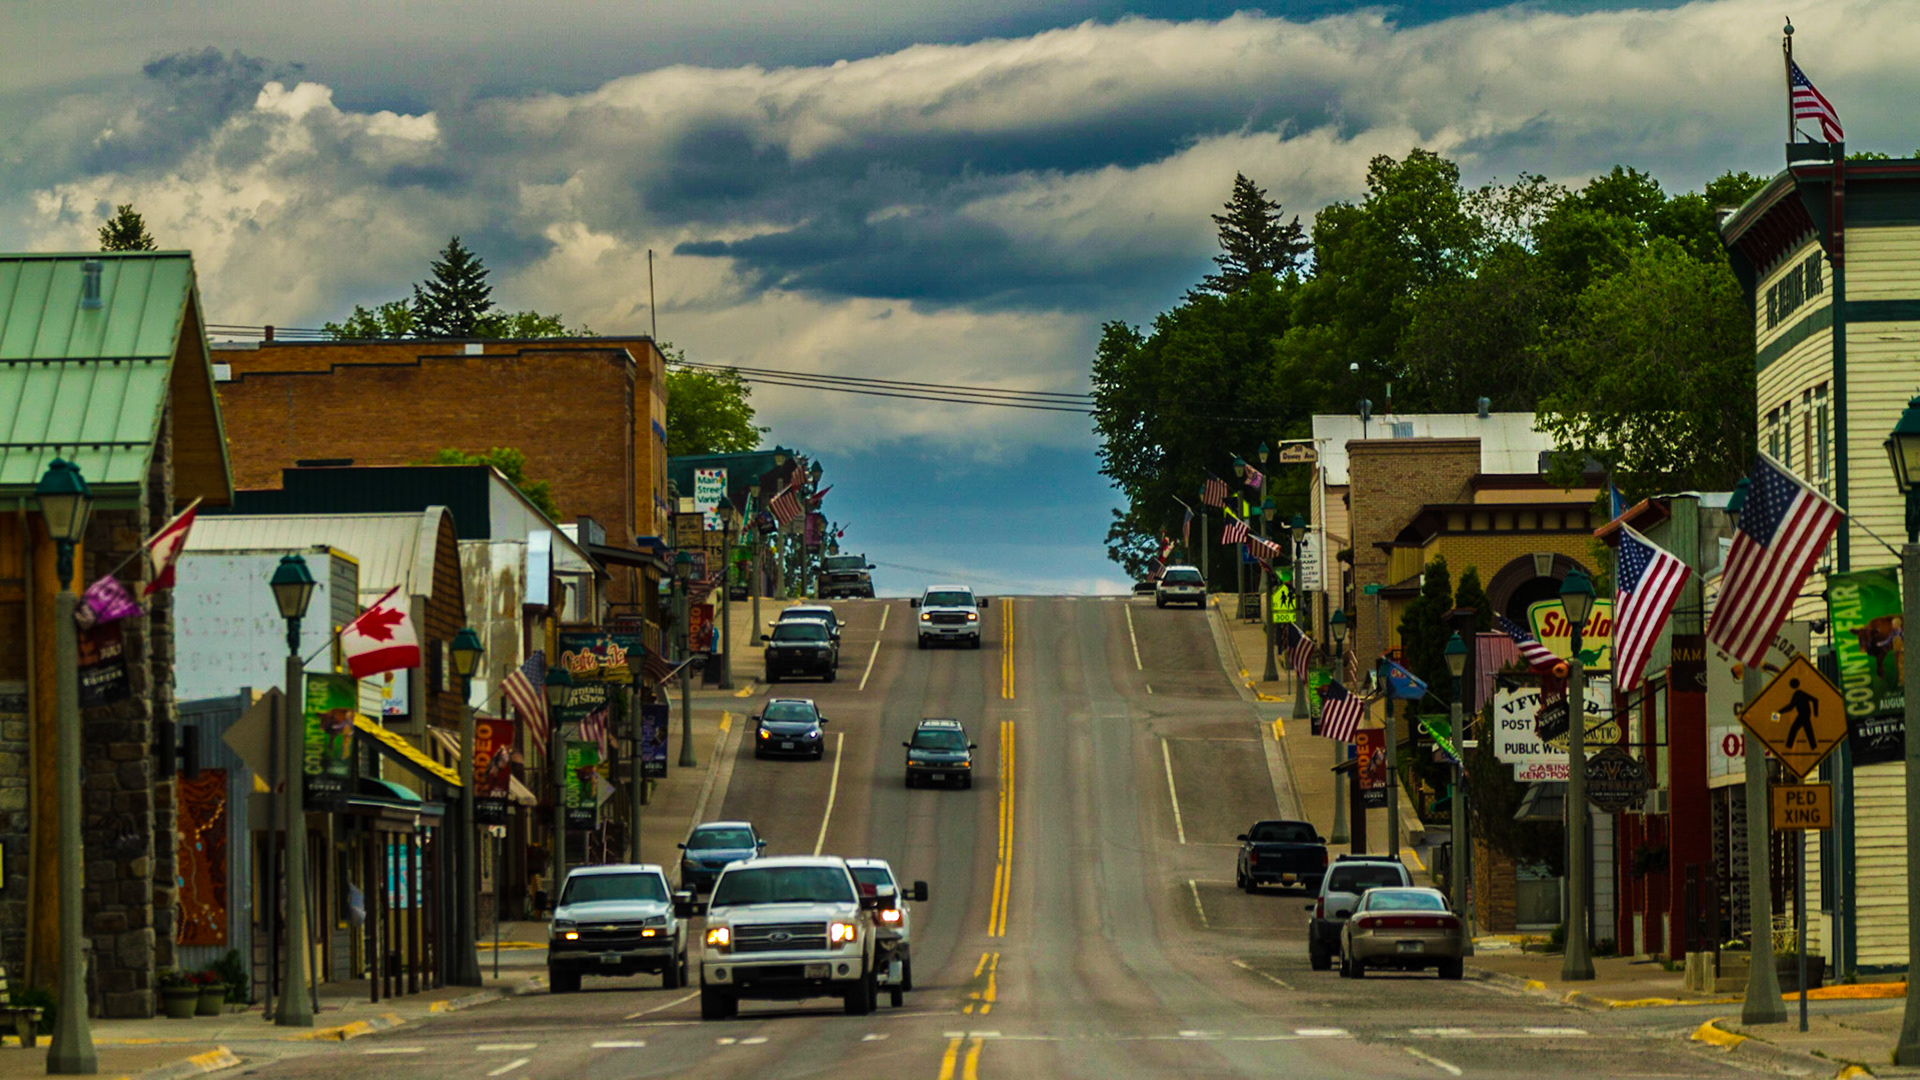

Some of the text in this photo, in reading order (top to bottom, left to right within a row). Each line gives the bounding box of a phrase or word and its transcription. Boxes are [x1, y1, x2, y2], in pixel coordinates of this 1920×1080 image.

[698, 476, 718, 485] Main
[690, 607, 702, 652] RODEO
[1831, 584, 1876, 717] COUNTY FAIR
[1879, 696, 1905, 712] AUGUS
[1502, 720, 1531, 731] POST
[1858, 722, 1905, 738] EUREKA
[304, 714, 326, 776] COUNTY
[1505, 743, 1540, 755] PUBLIC
[474, 723, 494, 798] RODEO
[1356, 733, 1373, 790] RODEO
[1786, 791, 1816, 806] PED
[1784, 808, 1821, 824] XING
